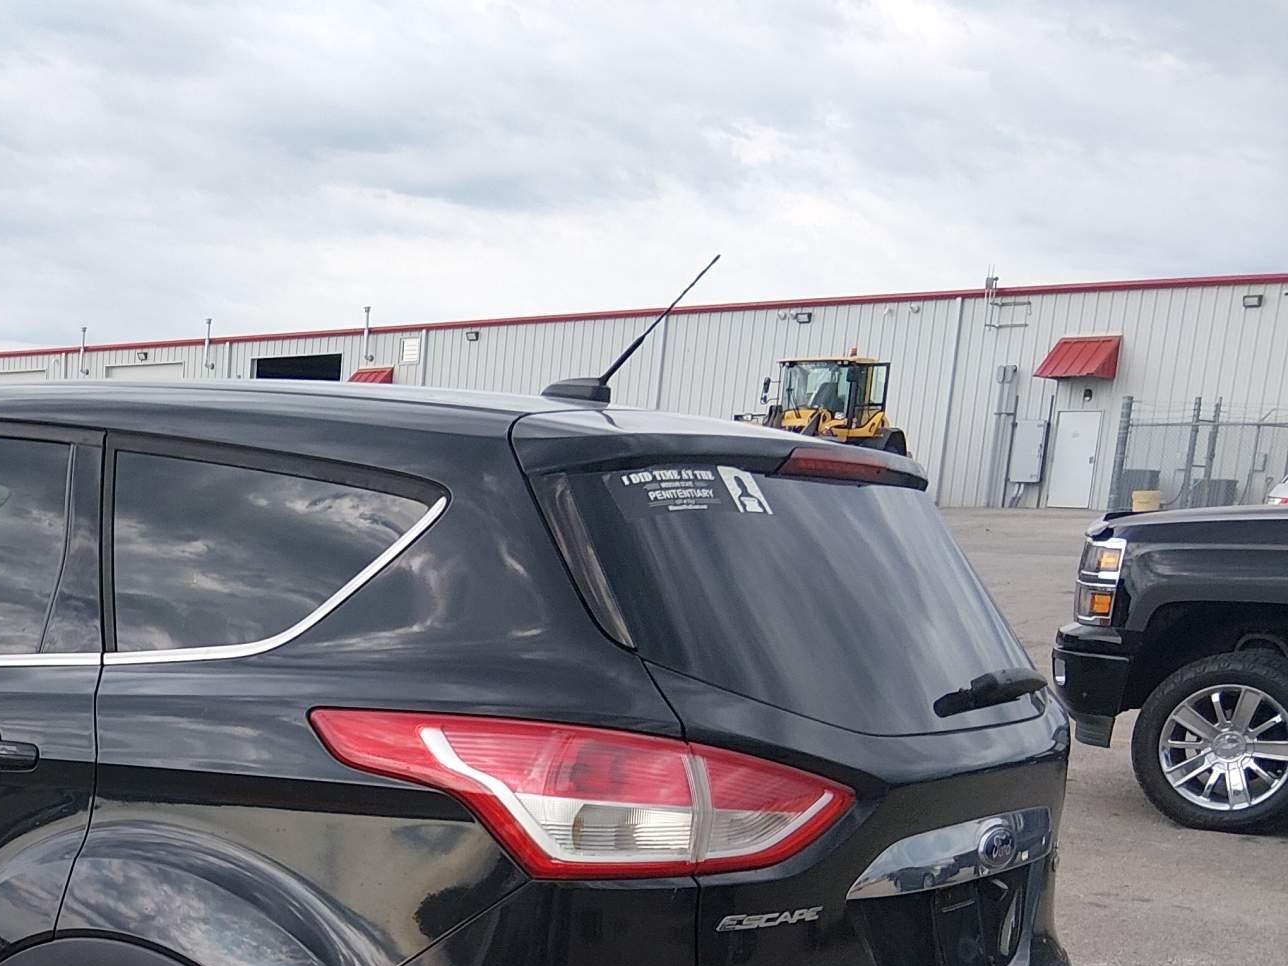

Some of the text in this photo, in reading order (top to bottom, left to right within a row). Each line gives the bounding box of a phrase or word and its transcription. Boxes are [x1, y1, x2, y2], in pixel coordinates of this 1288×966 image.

[621, 469, 715, 486] I DID TIME AT THE
[648, 488, 714, 501] PENITENTIARY
[716, 906, 824, 933] ESCAPE
